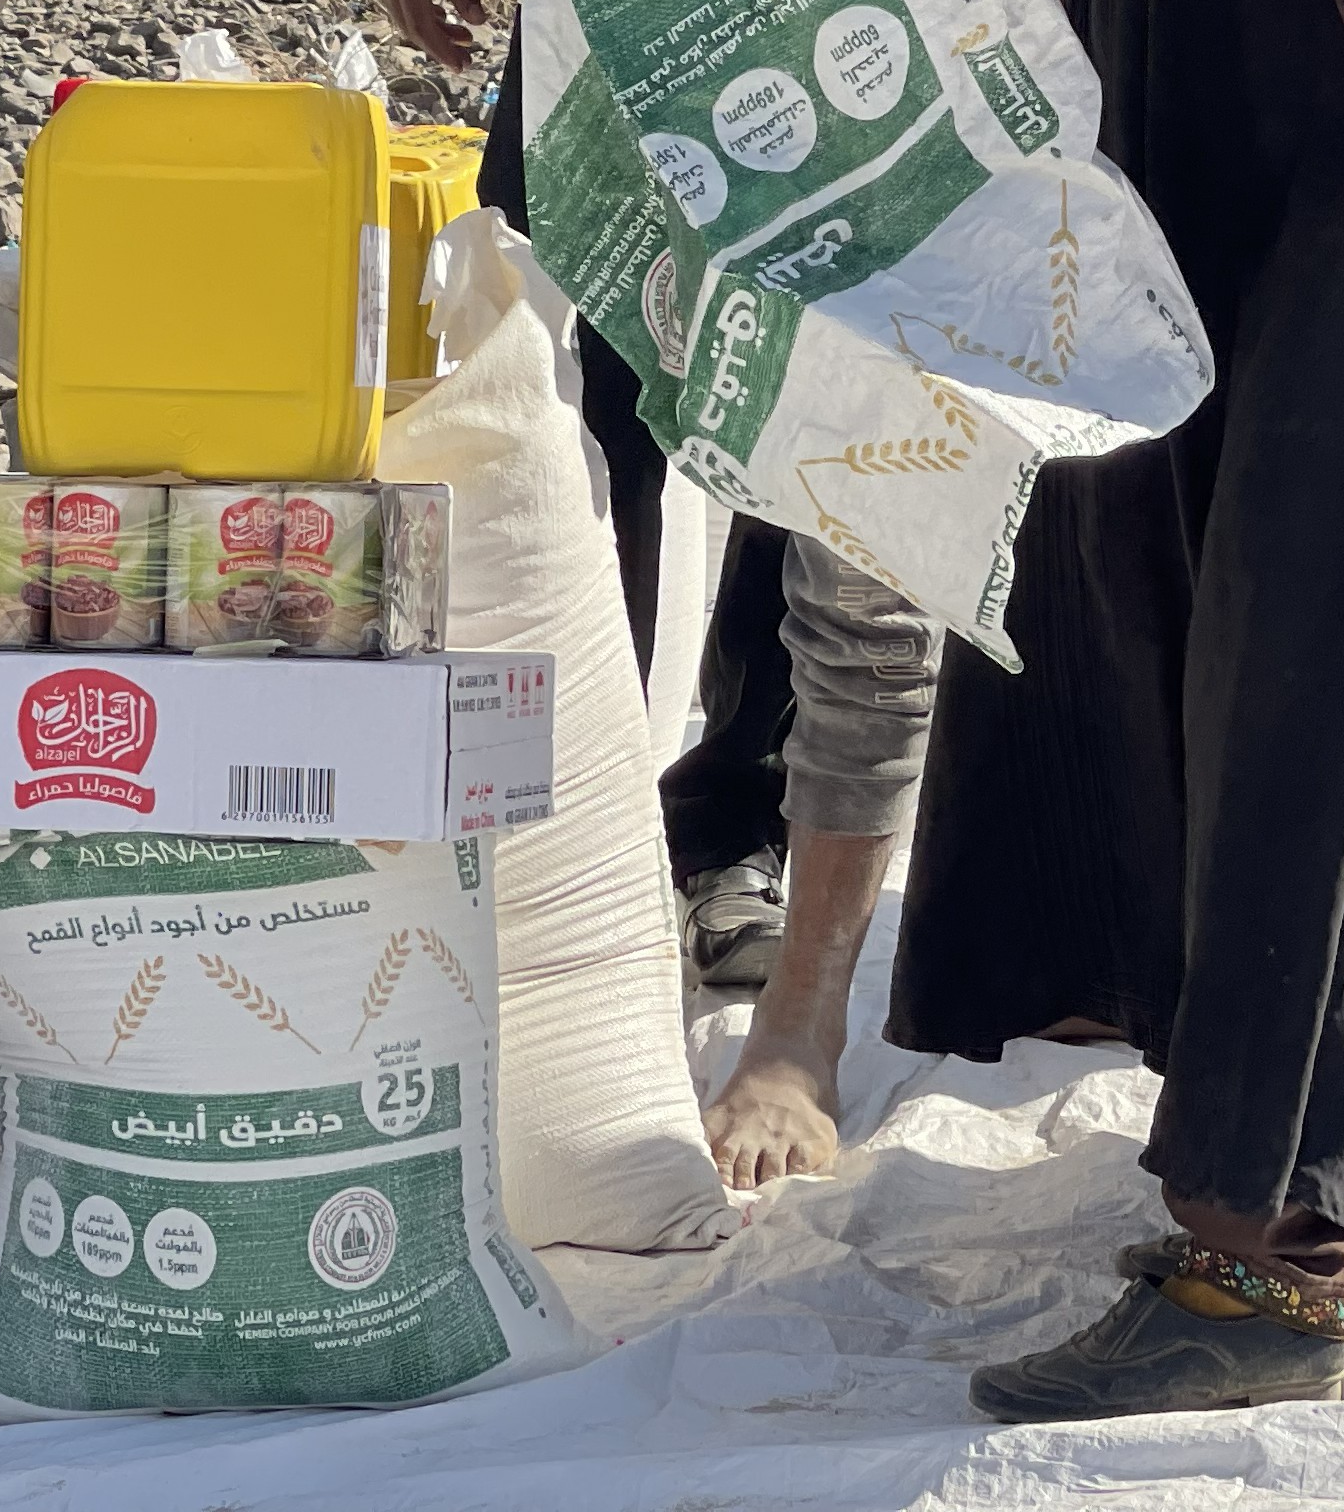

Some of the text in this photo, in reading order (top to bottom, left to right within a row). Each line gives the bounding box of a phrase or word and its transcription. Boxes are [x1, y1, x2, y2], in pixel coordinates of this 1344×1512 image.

[830, 24, 880, 63] 60ppm
[840, 44, 889, 85] بالحديد
[722, 81, 785, 125] 189ppm
[655, 143, 687, 170] 1.5pp
[572, 196, 635, 283] www.ycfms.com
[597, 234, 630, 280] FLOUR
[698, 218, 854, 431] دقيق أبيض
[35, 745, 81, 764] alzajel
[28, 776, 143, 806] فاصوليا حمراء
[284, 813, 330, 824] 156155
[27, 897, 370, 954] مستخلص من أجود أنواع القمح
[378, 1068, 425, 1113] 25
[112, 1102, 344, 1148] دقيق أبيض
[383, 1116, 396, 1128] KG
[81, 1240, 122, 1263] 189ppm
[158, 1258, 198, 1276] 1.5ppm
[236, 1326, 278, 1341] YEMEN
[355, 1310, 394, 1328] FLOUR
[314, 1313, 421, 1351] www.ycfms.com
